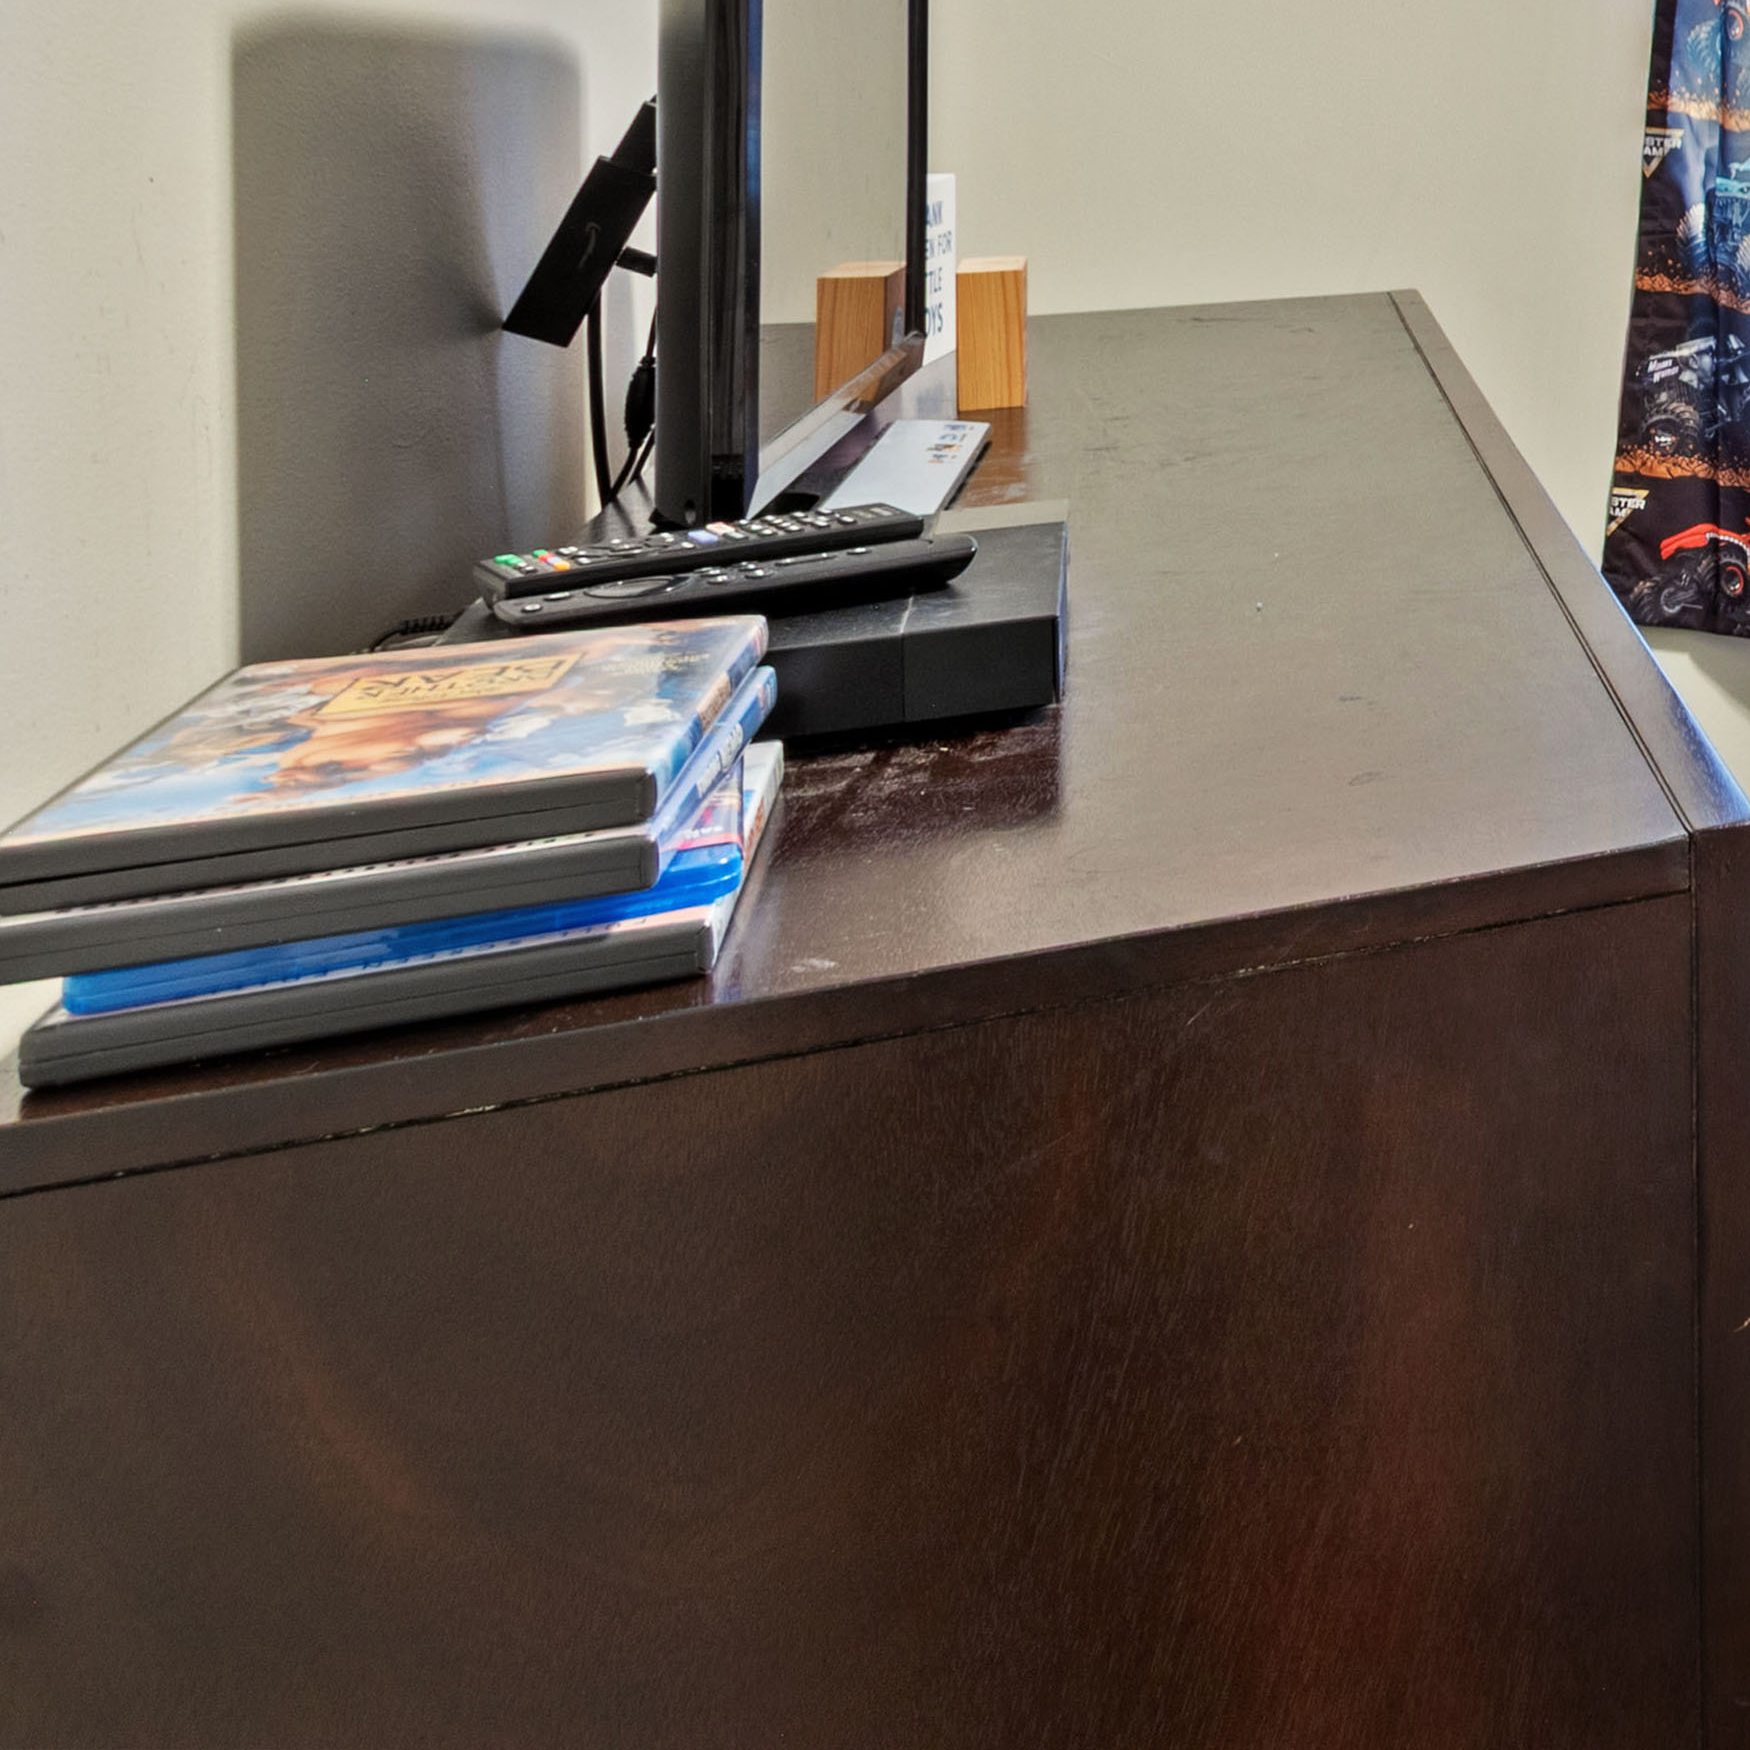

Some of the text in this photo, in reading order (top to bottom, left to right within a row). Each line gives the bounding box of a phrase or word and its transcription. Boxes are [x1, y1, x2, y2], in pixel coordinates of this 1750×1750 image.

[926, 200, 943, 228] ANK
[937, 230, 953, 255] FOR
[925, 302, 944, 339] OYS
